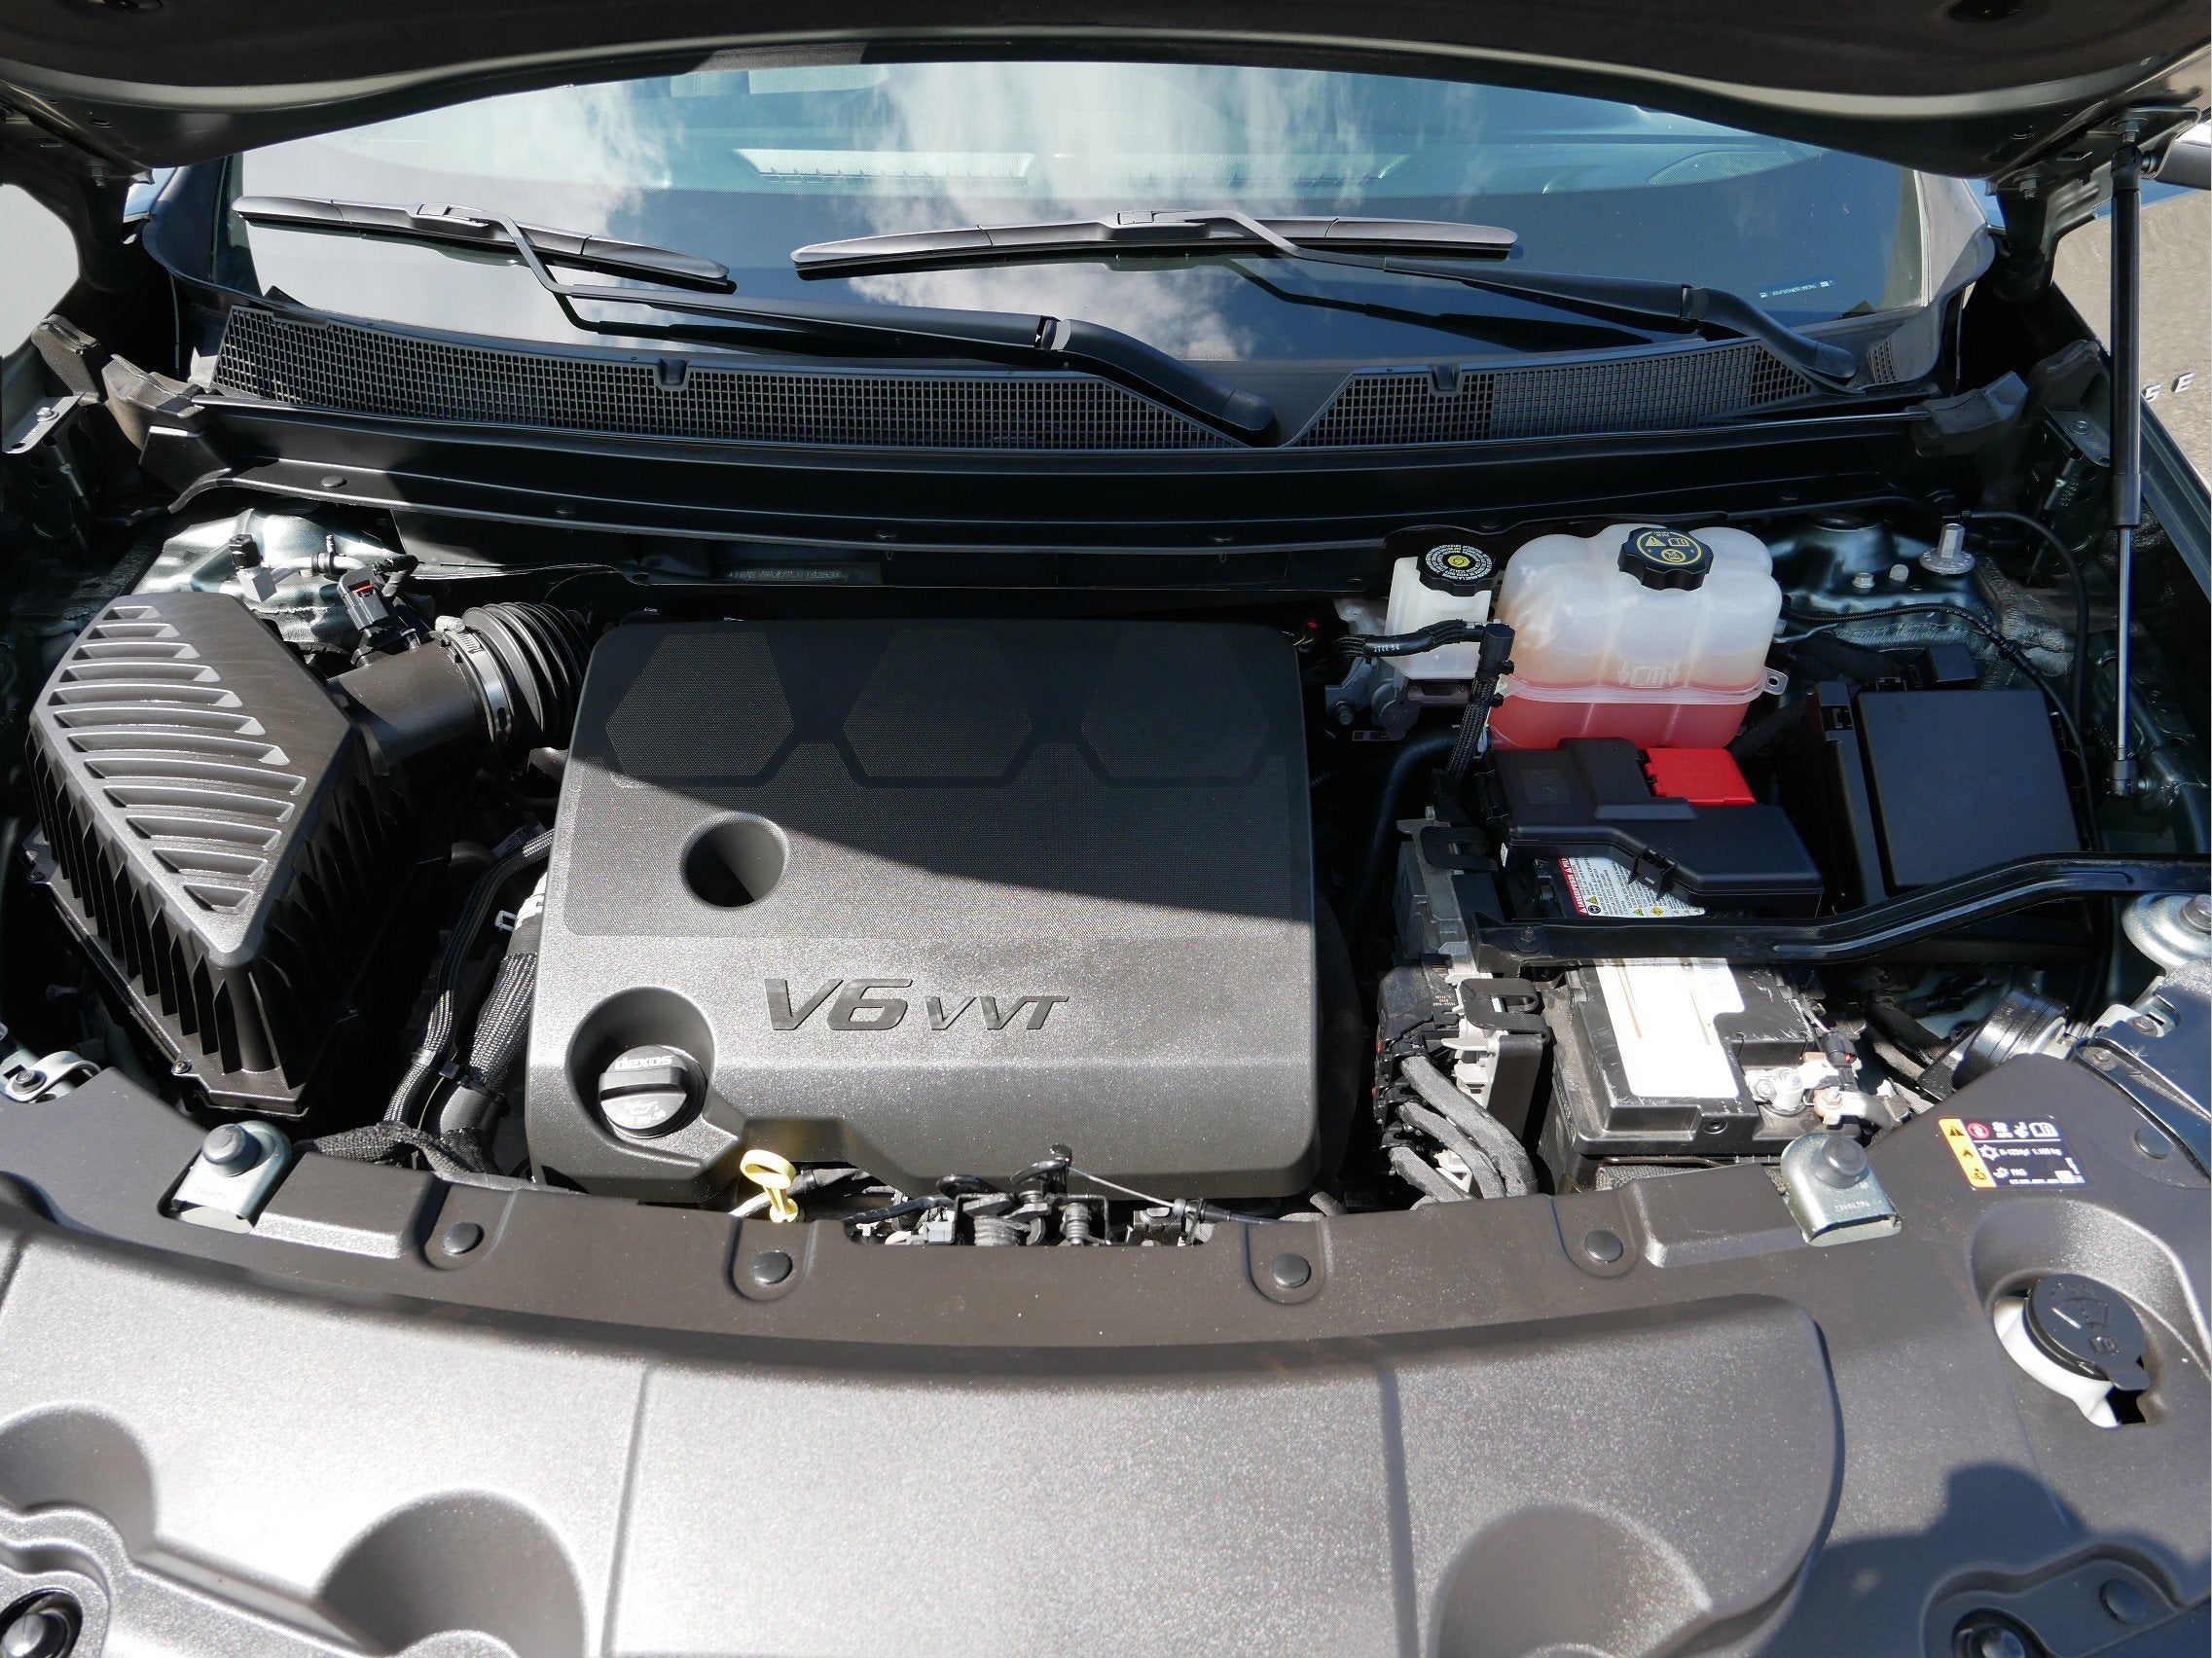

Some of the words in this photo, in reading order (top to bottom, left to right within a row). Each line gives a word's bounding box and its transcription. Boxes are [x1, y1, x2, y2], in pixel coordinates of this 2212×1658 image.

[764, 978, 913, 1031] V6
[925, 995, 1070, 1031] VVT
[614, 1055, 674, 1070] dexos
